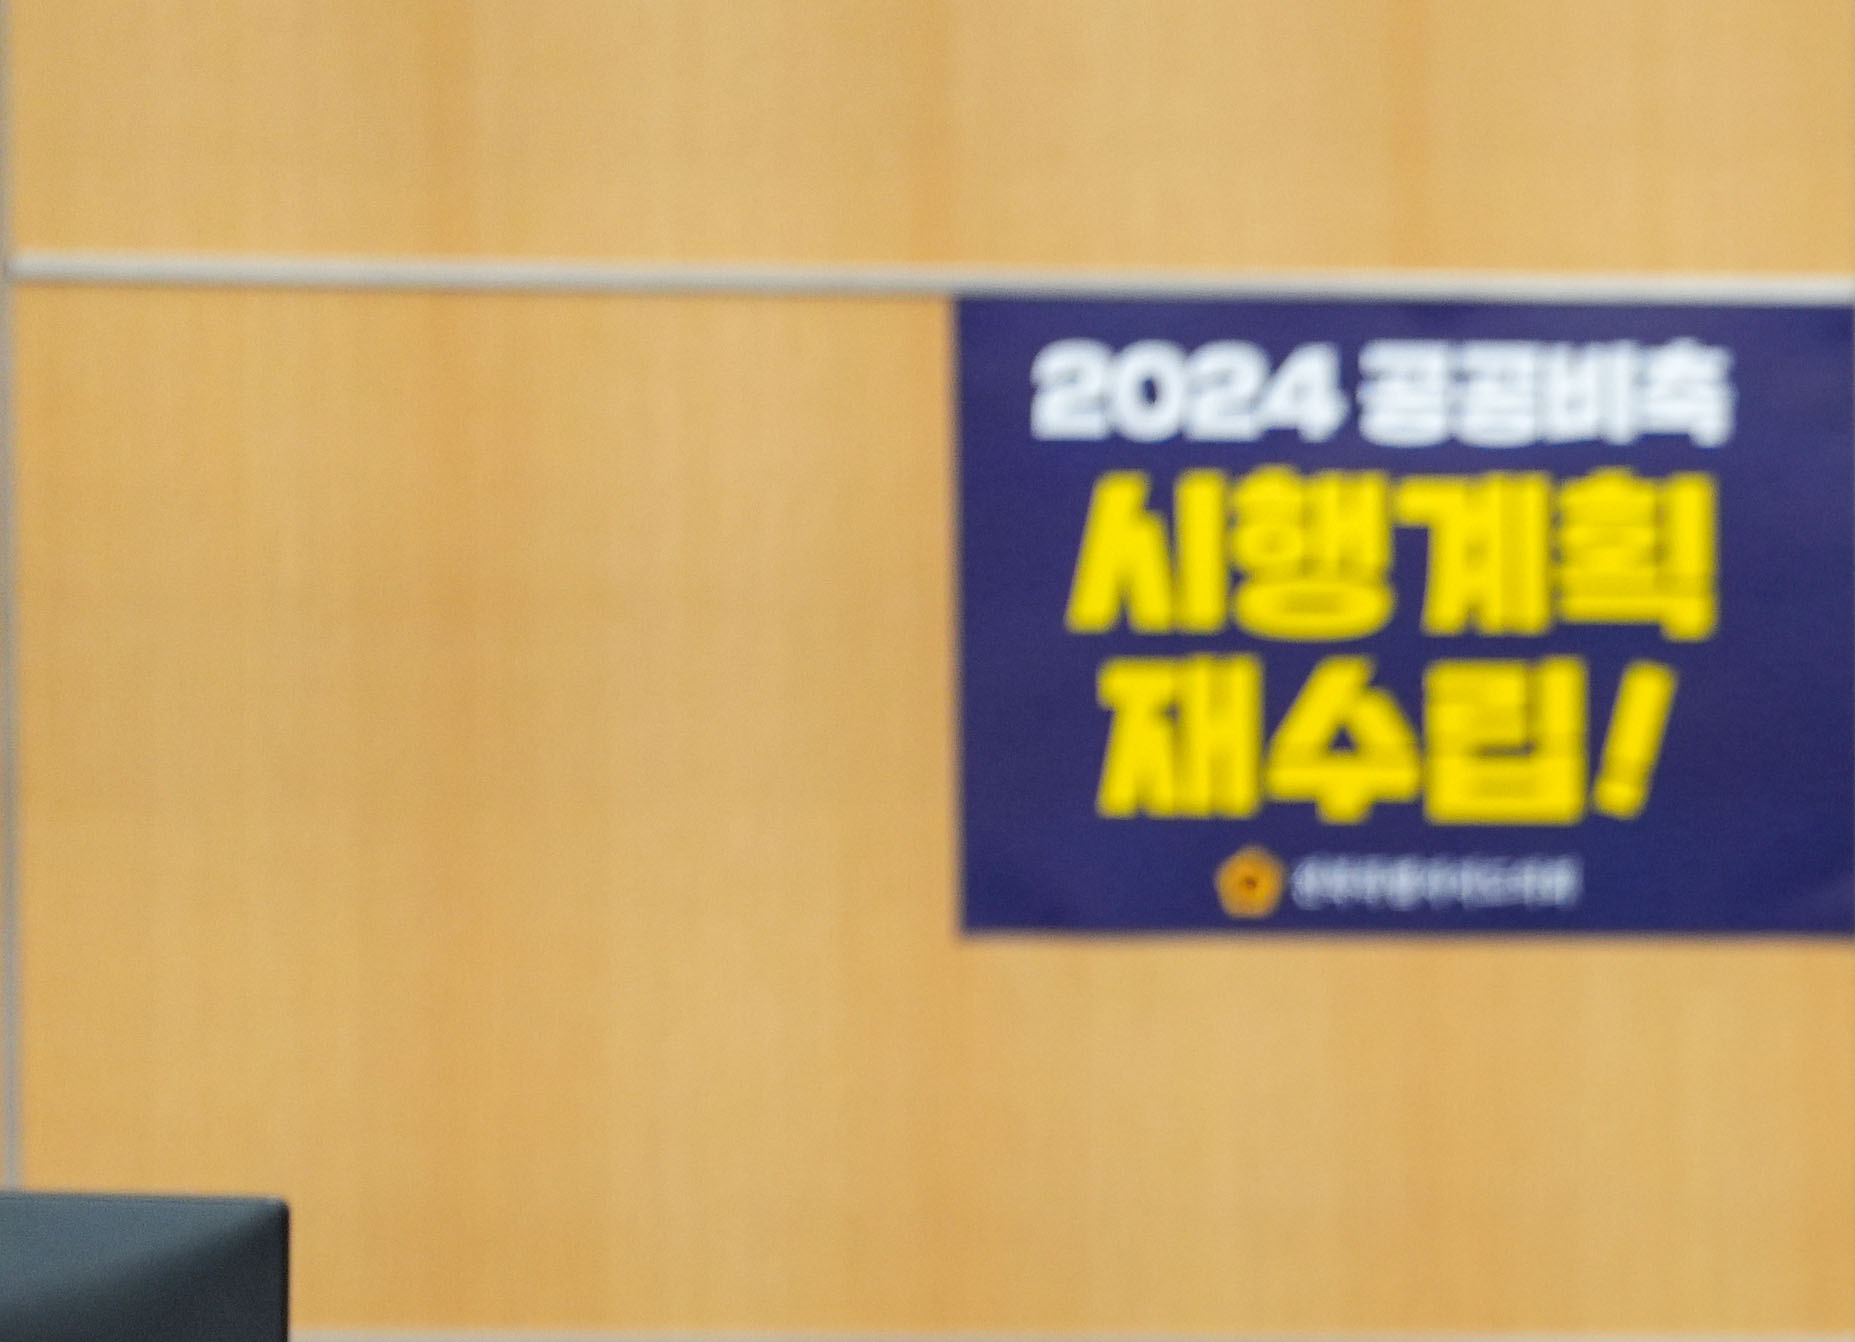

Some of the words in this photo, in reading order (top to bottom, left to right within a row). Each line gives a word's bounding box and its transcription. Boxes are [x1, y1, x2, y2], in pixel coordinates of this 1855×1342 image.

[1033, 340, 1348, 441] 2024
[1358, 339, 1733, 447] 공공비축
[1067, 466, 1718, 641] 시행계획
[1097, 653, 1677, 825] 재수립!
